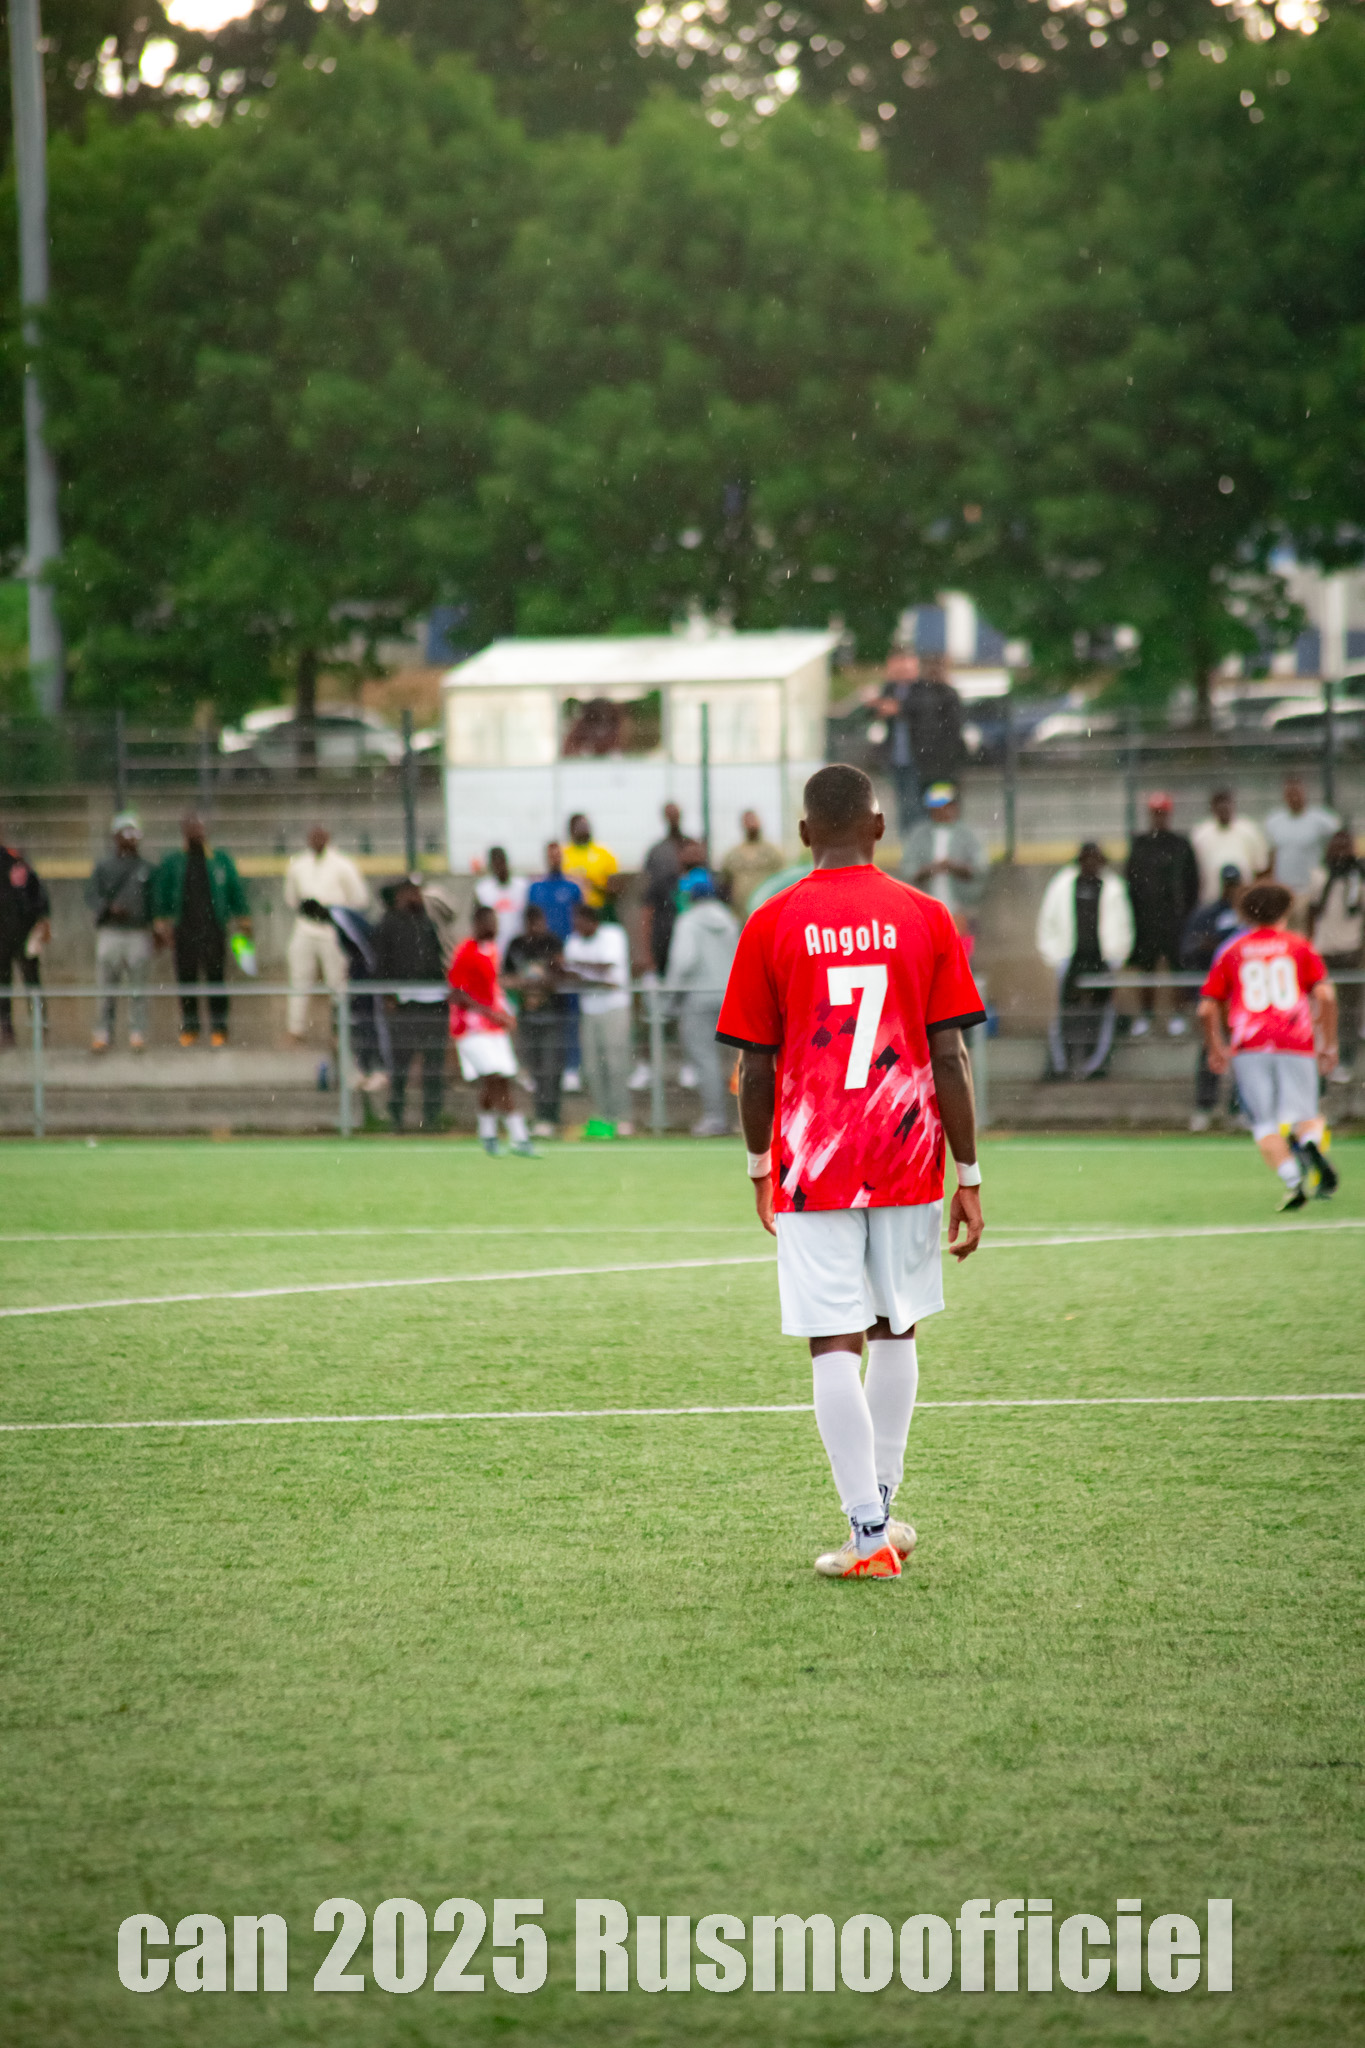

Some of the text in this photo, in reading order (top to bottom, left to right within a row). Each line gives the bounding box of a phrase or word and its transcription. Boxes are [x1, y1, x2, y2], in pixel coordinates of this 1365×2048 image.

[804, 918, 897, 957] Angola
[1240, 957, 1298, 1012] 80
[826, 964, 888, 1090] 7
